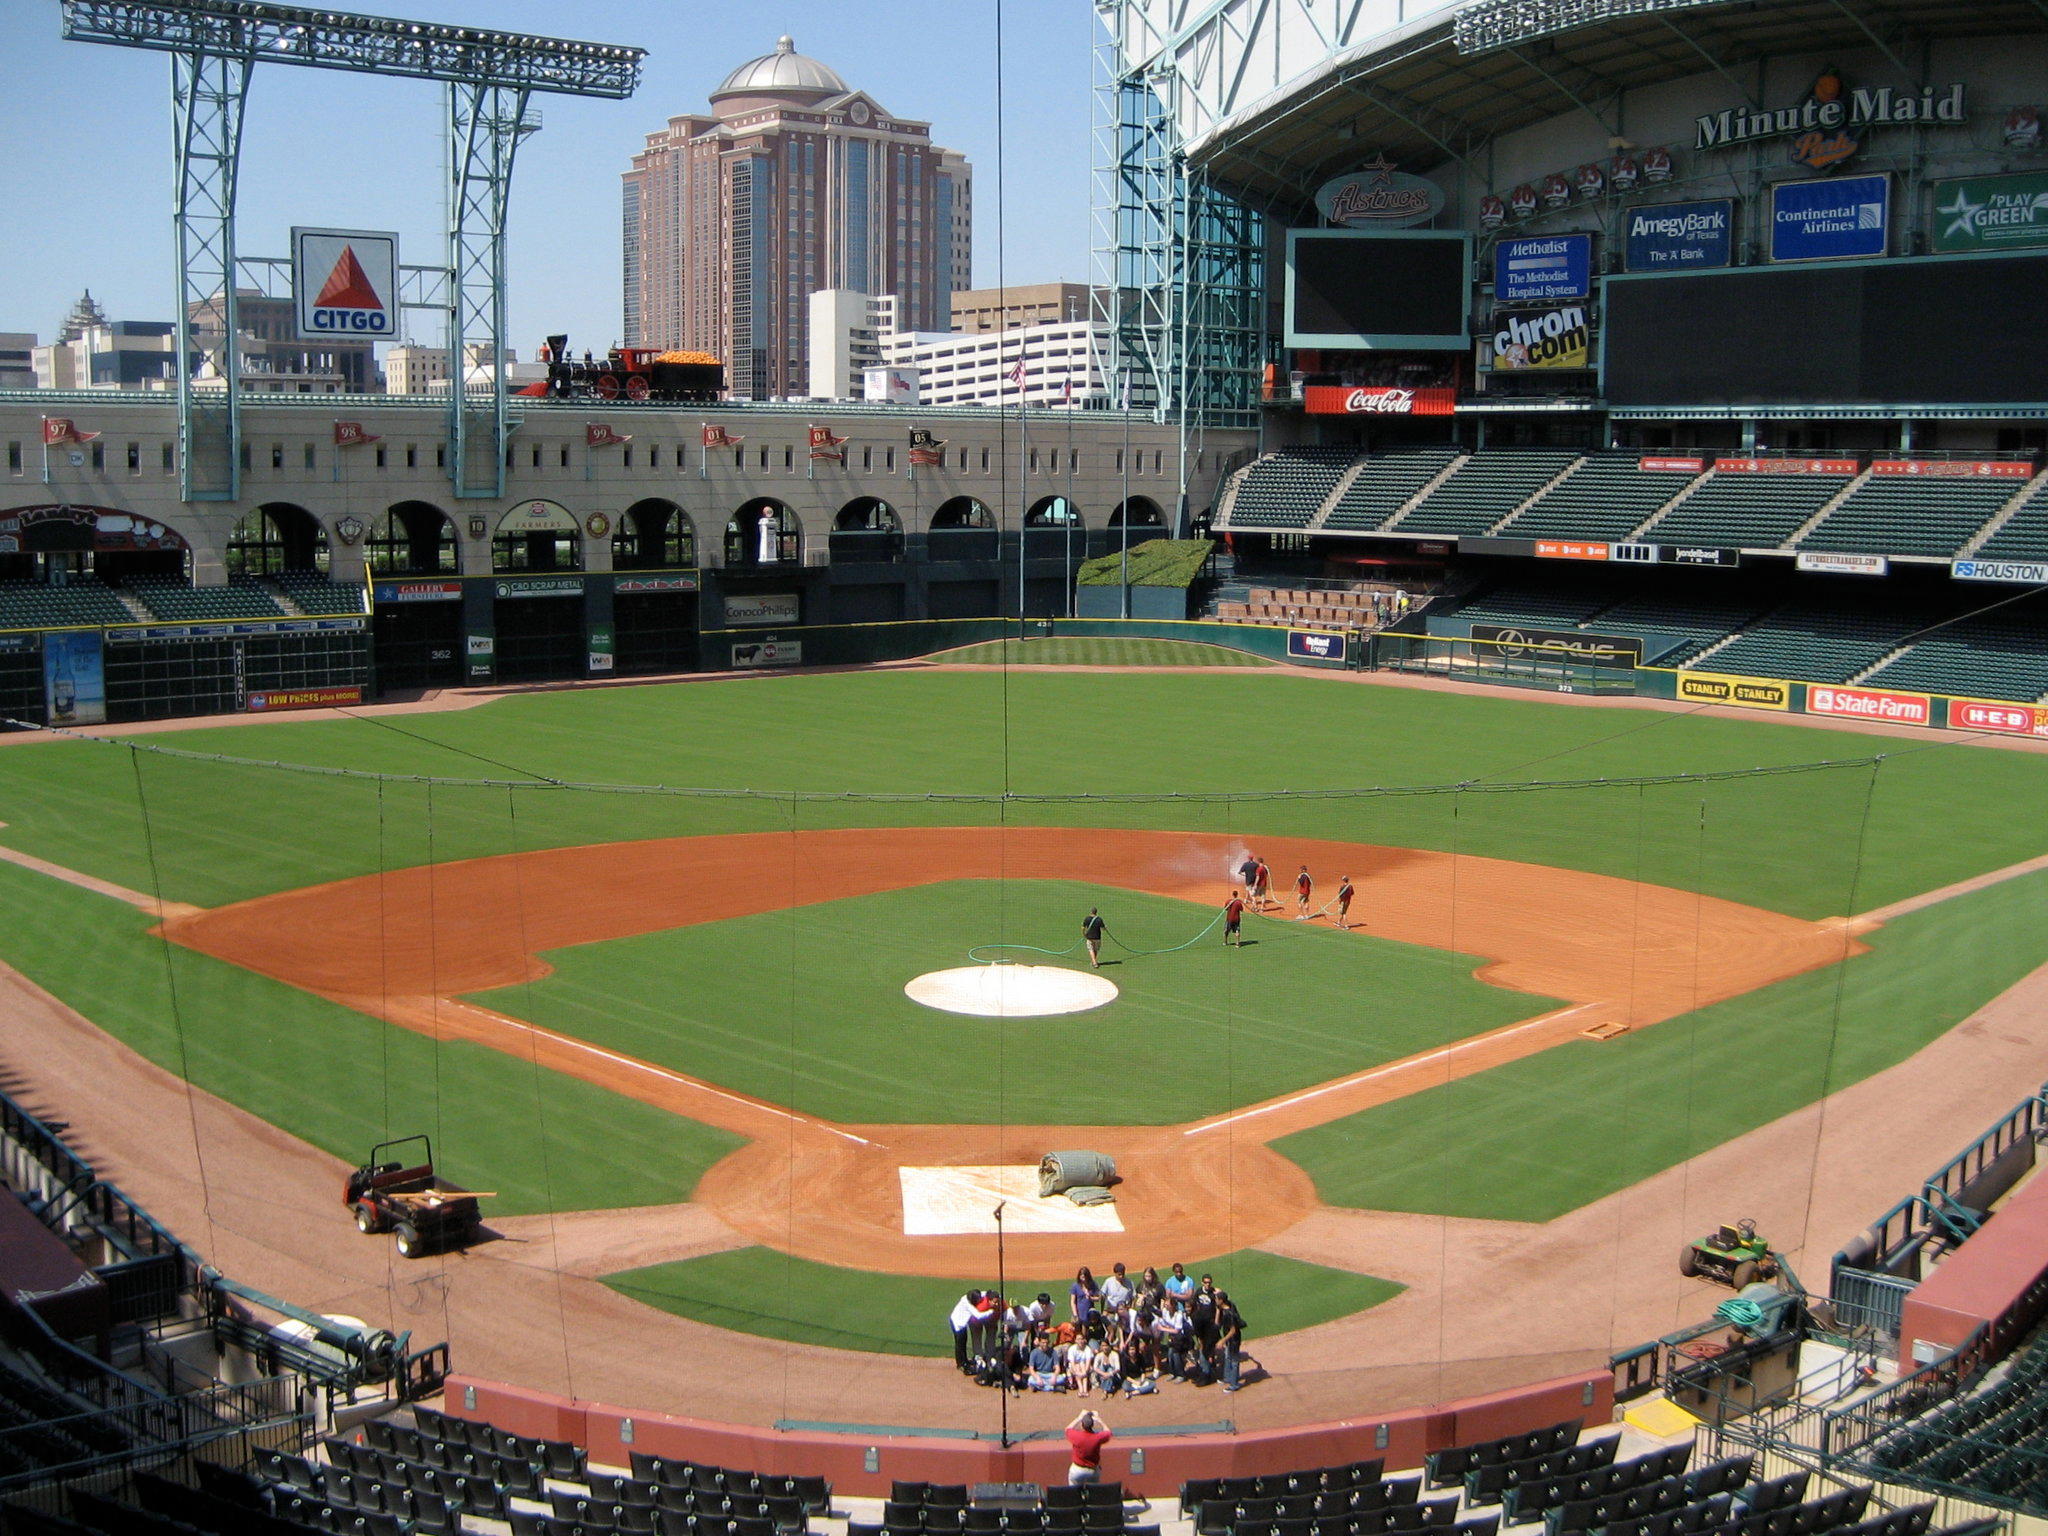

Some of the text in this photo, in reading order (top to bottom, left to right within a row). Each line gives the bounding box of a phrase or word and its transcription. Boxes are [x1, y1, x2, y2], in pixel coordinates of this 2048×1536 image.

[1695, 83, 1964, 149] Minute Maid
[1331, 183, 1430, 222] Astros
[1996, 193, 2032, 207] PLAY
[1776, 205, 1855, 222] Continental
[1974, 206, 2034, 226] GREEN
[1802, 220, 1855, 234] Airlines
[1509, 240, 1569, 257] Methodist
[1650, 251, 1667, 261] The
[1680, 249, 1704, 260] Bank
[1508, 270, 1569, 284] The Methodist
[1508, 285, 1578, 299] Hospital System
[313, 309, 386, 331] CITGO
[1494, 307, 1584, 356] chron
[50, 424, 67, 436] 97
[341, 426, 357, 438] 98
[593, 429, 607, 438] 99
[707, 429, 720, 440] 01
[814, 431, 827, 441] 04
[914, 433, 926, 443] 05
[516, 521, 562, 529] FARMERS
[401, 583, 446, 593] GALLERY
[531, 581, 556, 590] SCRAP
[557, 580, 580, 589] METAL
[726, 604, 796, 618] ConocoPhillips
[1306, 635, 1330, 648] Reliant
[432, 650, 451, 659] 362
[1310, 645, 1328, 656] Energy
[1558, 685, 1573, 693] 373
[1685, 682, 1727, 696] STANLEY
[1736, 687, 1780, 701] STANLEY
[269, 695, 287, 705] LOW
[289, 692, 319, 703] PRICES
[1969, 709, 2023, 726] H-E-B
